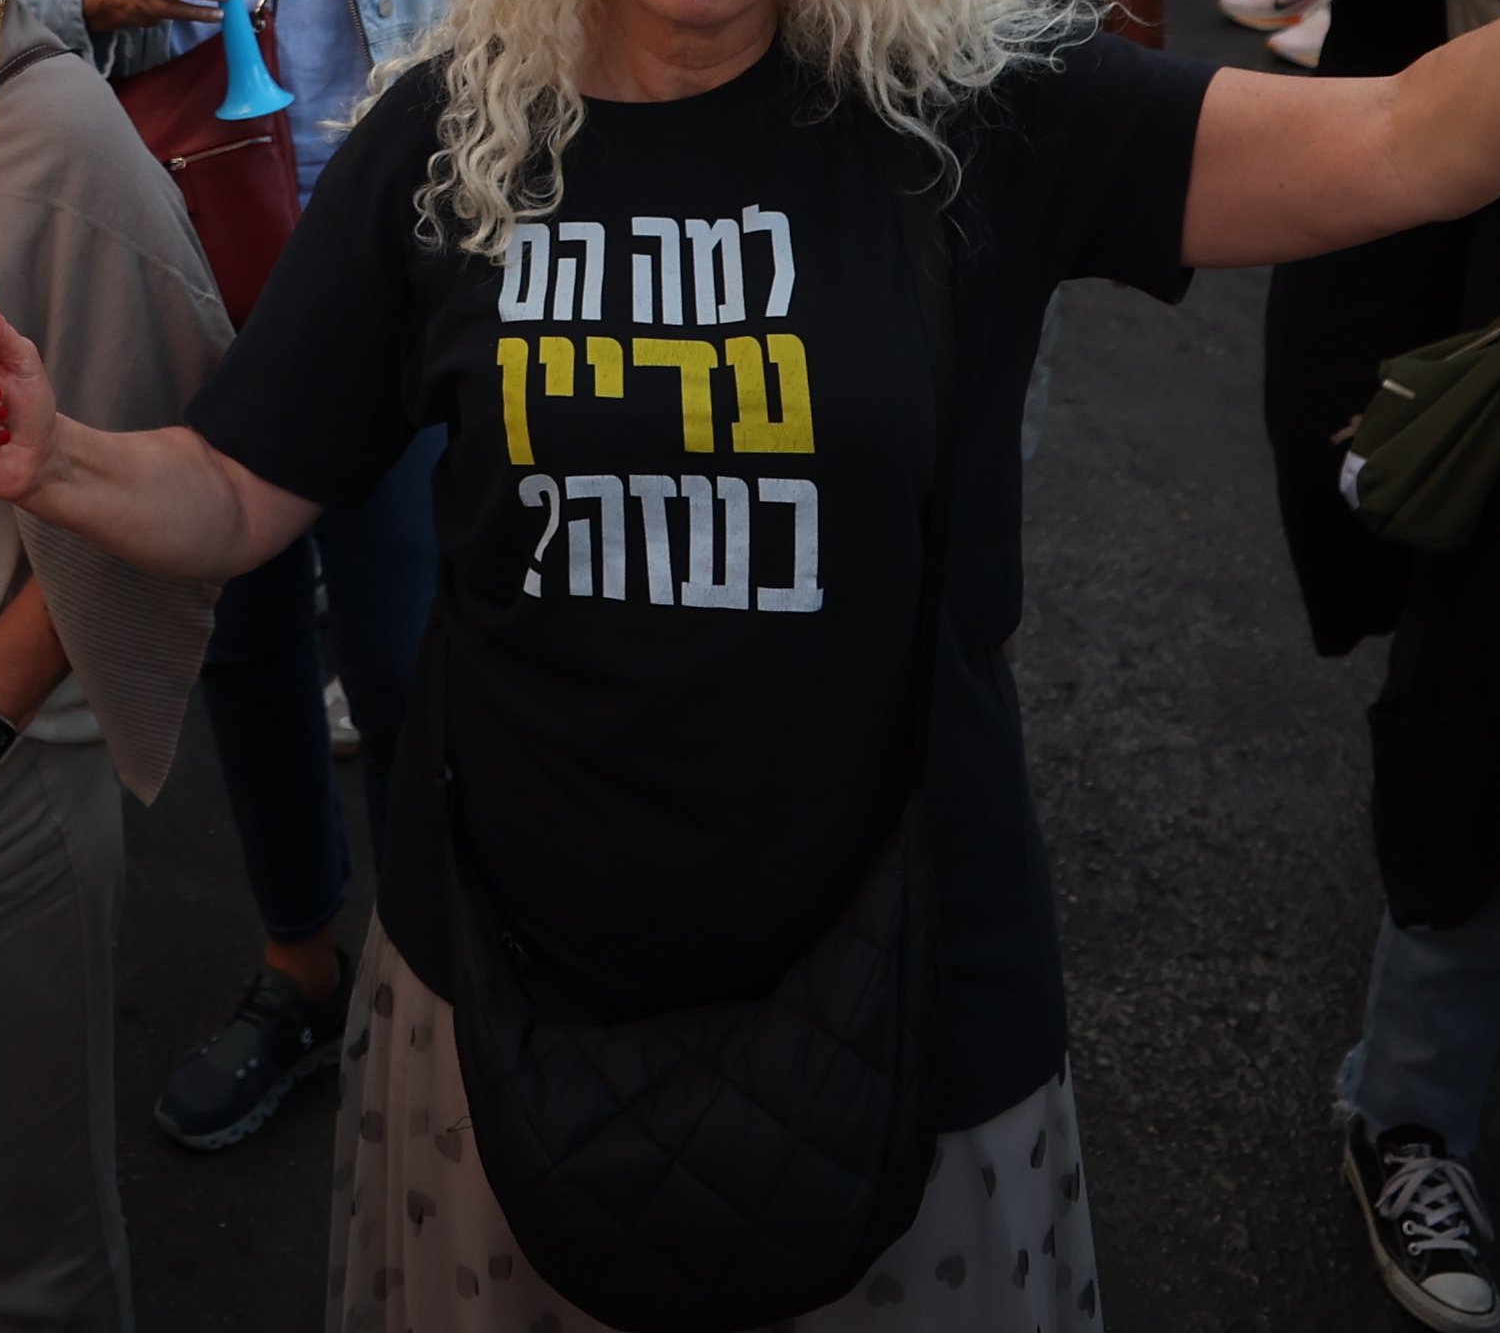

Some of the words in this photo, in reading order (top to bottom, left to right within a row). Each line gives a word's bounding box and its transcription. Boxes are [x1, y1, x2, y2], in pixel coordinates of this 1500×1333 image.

[498, 220, 606, 323] הם
[631, 203, 796, 325] למה
[496, 333, 816, 466] עדיין
[518, 473, 824, 613] בעזה?
